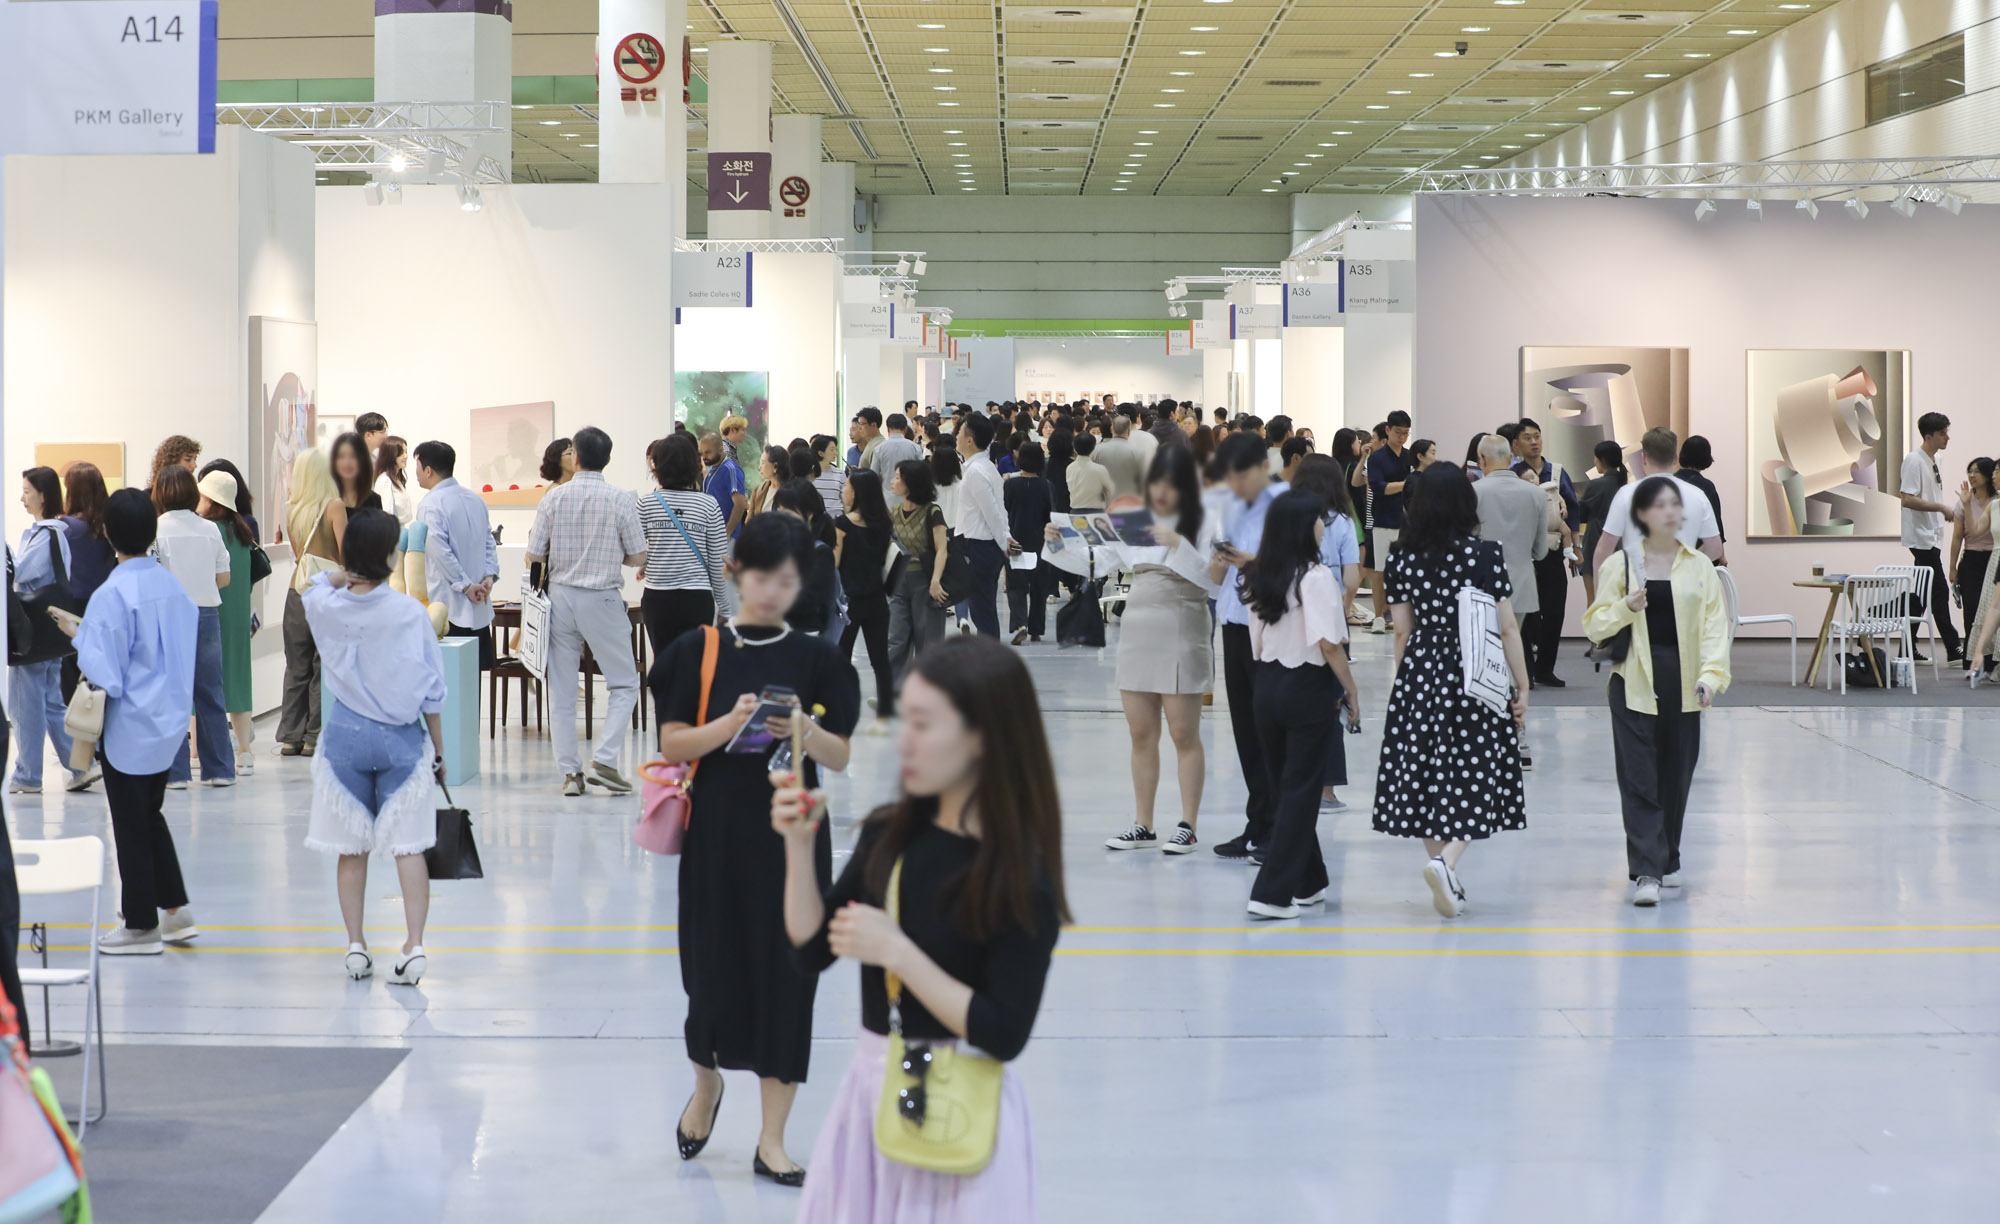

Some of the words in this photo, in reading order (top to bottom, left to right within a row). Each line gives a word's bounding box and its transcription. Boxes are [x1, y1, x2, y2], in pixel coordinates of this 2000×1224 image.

[121, 15, 184, 43] A14
[620, 87, 657, 102] 금연
[74, 109, 112, 125] PKM
[118, 108, 184, 127] Gallery
[722, 160, 754, 172] 소화전
[716, 256, 741, 268] A23
[1349, 264, 1373, 276] A35
[688, 291, 709, 299] Sadie
[710, 291, 730, 299] Coles
[731, 291, 741, 299] HQ
[1291, 287, 1312, 297] A36
[1349, 297, 1368, 305] Kiang
[1369, 297, 1400, 305] Malingue
[871, 306, 887, 314] A34
[1238, 307, 1254, 315] A37
[910, 316, 920, 324] B2
[1312, 313, 1332, 321] Gallery
[1487, 658, 1500, 673] THE
